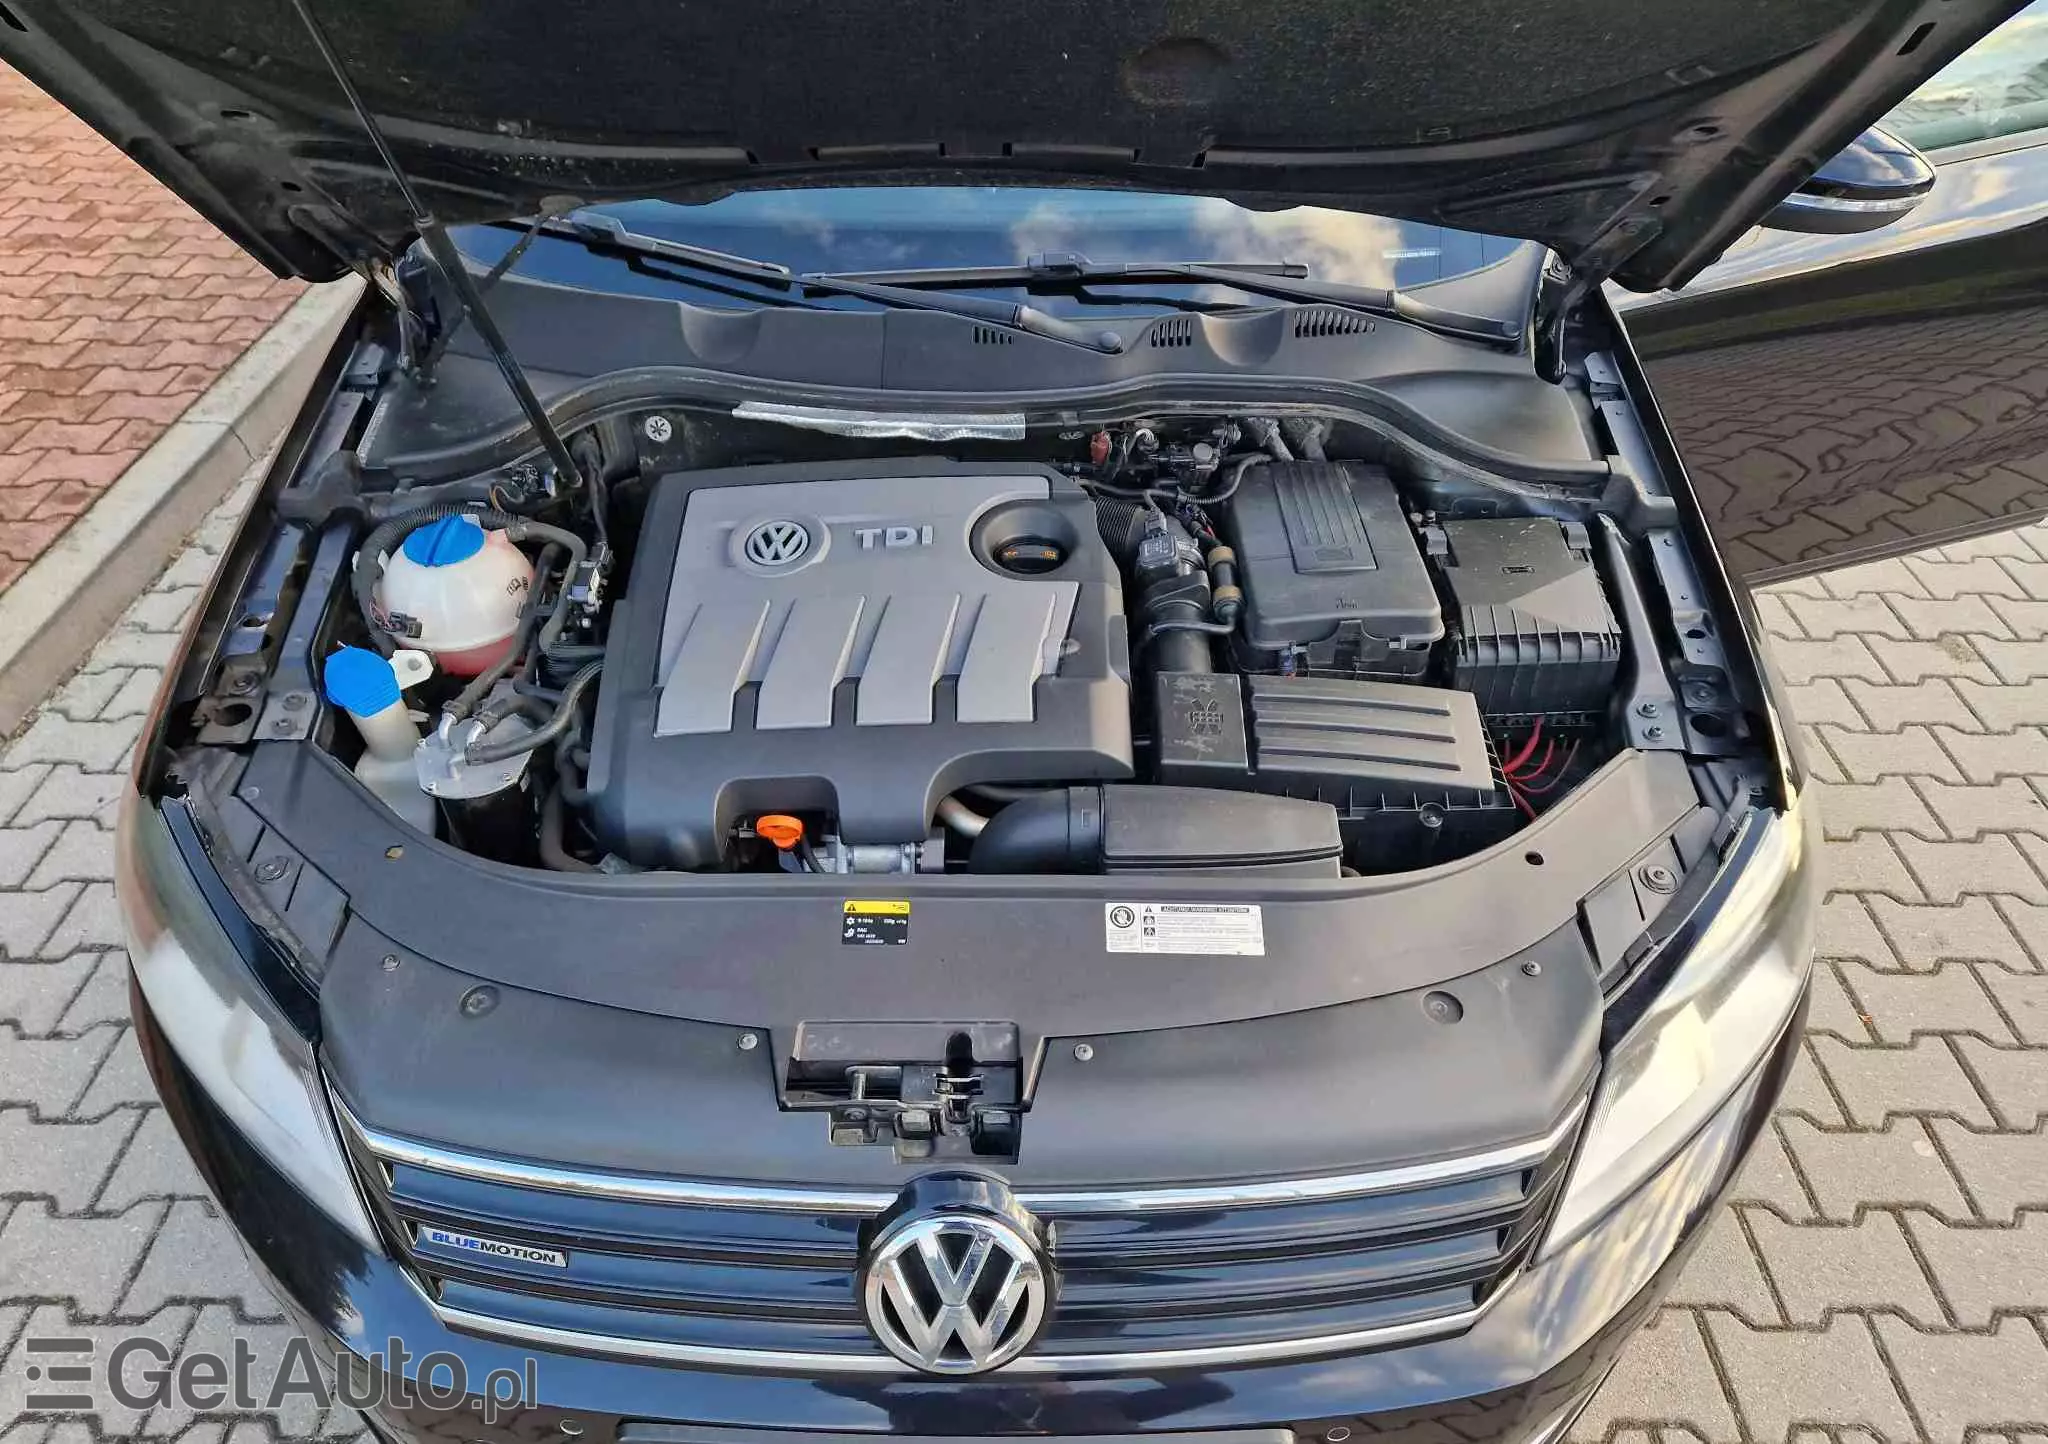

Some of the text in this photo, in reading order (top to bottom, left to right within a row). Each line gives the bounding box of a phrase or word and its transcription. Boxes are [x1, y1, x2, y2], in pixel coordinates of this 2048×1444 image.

[746, 521, 808, 565] VW
[855, 525, 934, 549] TDI
[431, 1231, 556, 1263] BLUEMOTION
[866, 1215, 1045, 1374] VW
